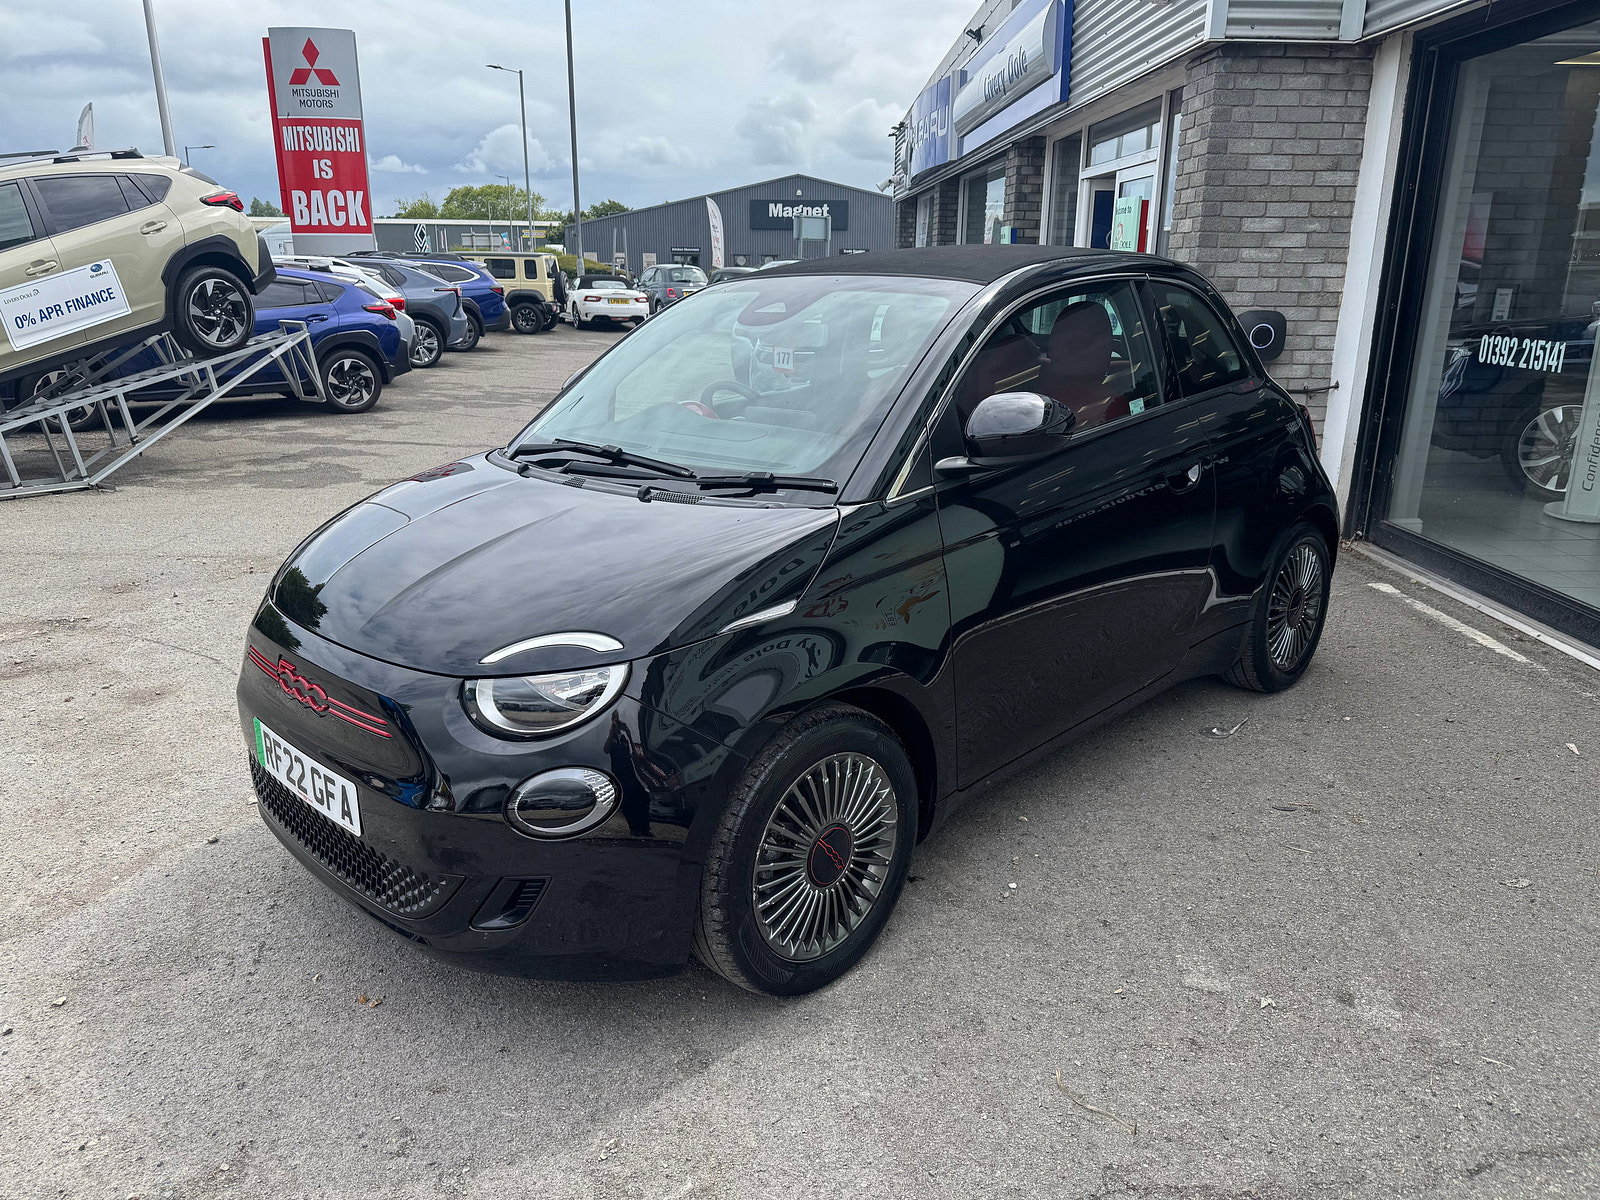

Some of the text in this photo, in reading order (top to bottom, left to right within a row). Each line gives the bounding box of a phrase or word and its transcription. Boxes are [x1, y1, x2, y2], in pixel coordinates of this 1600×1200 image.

[983, 45, 1028, 102] Livery Dole
[291, 88, 340, 98] MITSUBISHI
[299, 99, 334, 109] MOTORS
[282, 125, 361, 153] MITSUBISHI
[911, 104, 949, 149] BARU
[312, 159, 334, 180] IS
[291, 189, 368, 227] BACK
[768, 203, 830, 219] Magnet
[14, 287, 116, 329] 0% APR FINANCE
[776, 351, 791, 365] 177
[1478, 334, 1567, 374] 01392 215141
[1581, 413, 1600, 492] Confiden
[262, 729, 354, 827] RF22 GFA
